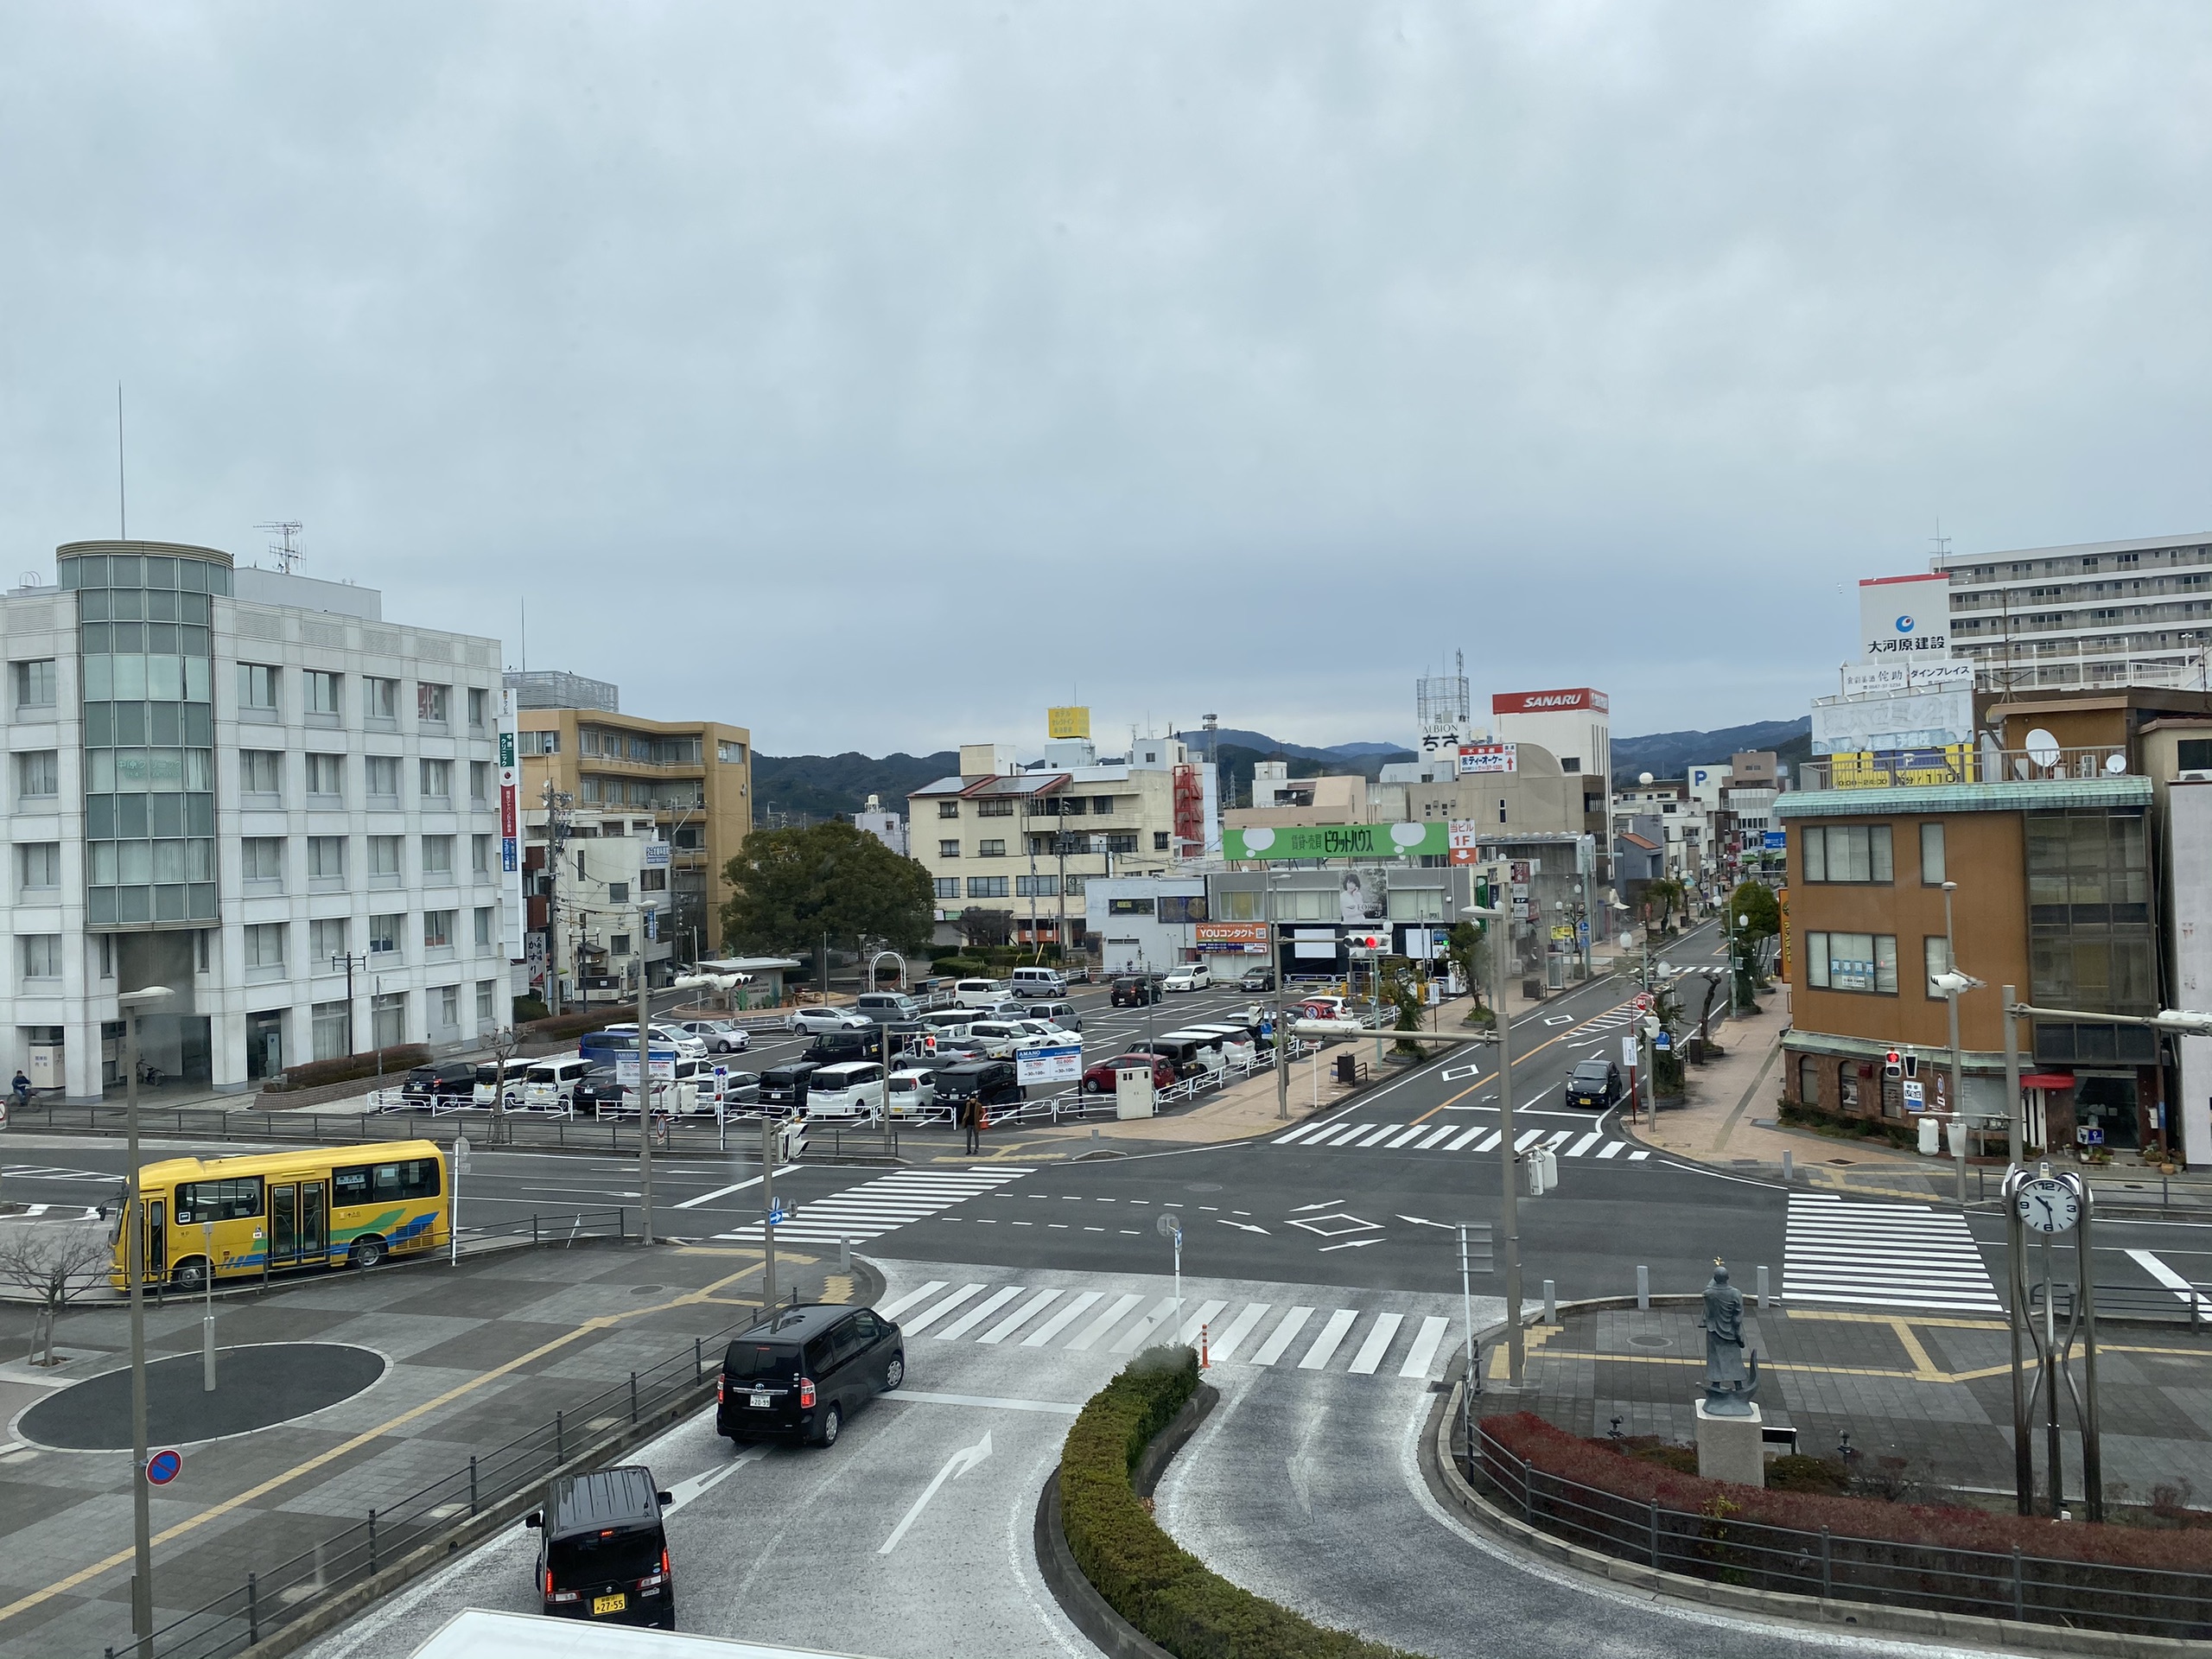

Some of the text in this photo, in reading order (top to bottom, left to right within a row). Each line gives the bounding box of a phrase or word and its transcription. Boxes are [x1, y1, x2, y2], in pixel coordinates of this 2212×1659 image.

[1868, 636, 1945, 654] 大河原建設
[1910, 665, 1969, 678] ダインプレイス
[1522, 694, 1582, 708] SANARU
[1422, 724, 1458, 734] ALBION
[1695, 771, 1707, 786] P
[1450, 823, 1474, 832] 当ビル
[1291, 830, 1374, 853] 賃貸・売買 ピタットハウス
[1454, 835, 1471, 846] 1F
[1200, 929, 1255, 938] YOUコンタクト
[528, 940, 537, 975] かすり
[2038, 1182, 2056, 1191] 12
[2020, 1201, 2030, 1210] 9
[2043, 1224, 2054, 1232] 6
[601, 1599, 624, 1611] 27-55
